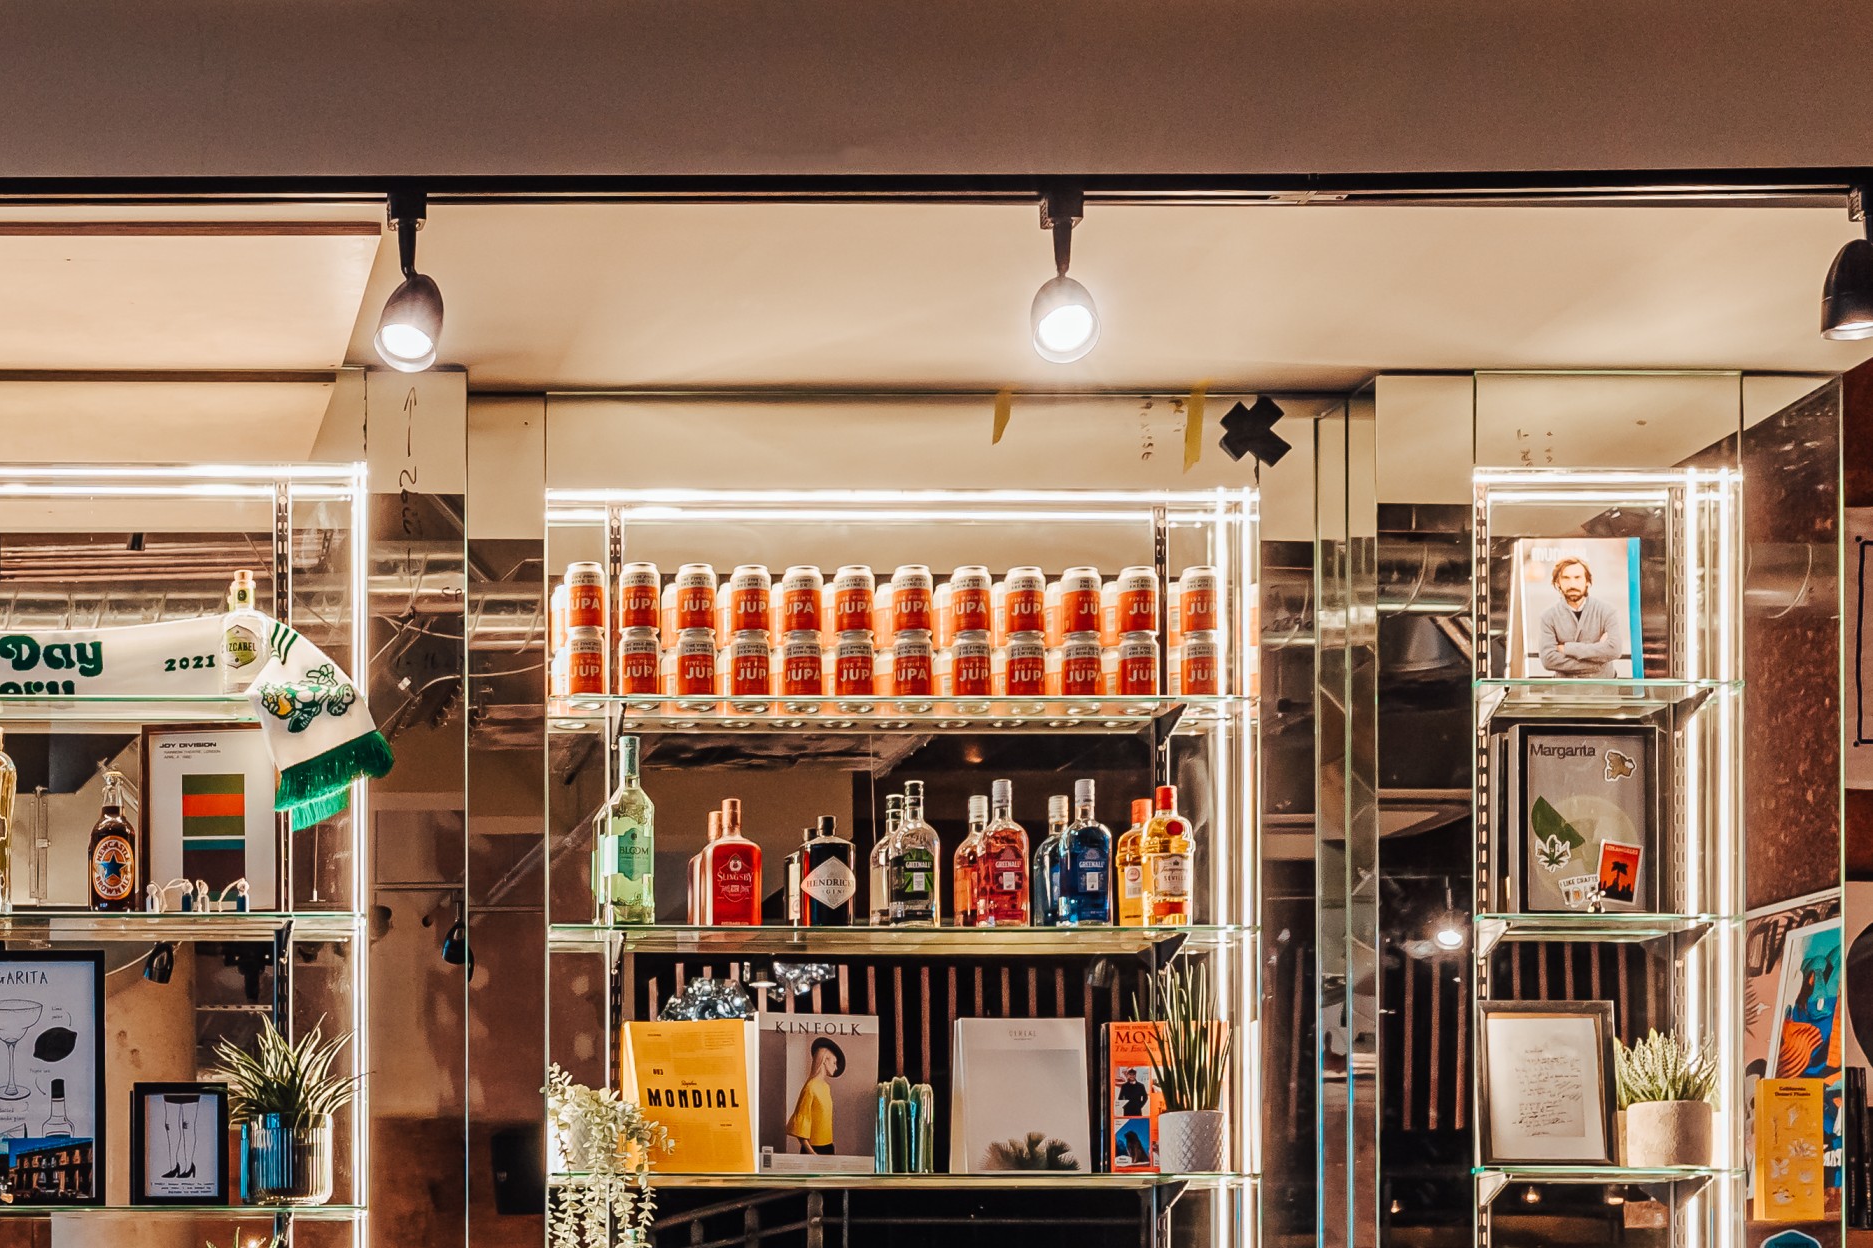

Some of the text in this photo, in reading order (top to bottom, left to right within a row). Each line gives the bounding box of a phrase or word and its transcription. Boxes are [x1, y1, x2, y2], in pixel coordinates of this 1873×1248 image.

[164, 654, 216, 672] 2021
[1530, 743, 1596, 758] Margarita
[96, 840, 130, 861] NEWCASTLE
[619, 846, 650, 855] BLOOM
[95, 875, 131, 894] BROWN ALE
[717, 871, 754, 883] SLINGSBY
[775, 1021, 862, 1036] KINFOLK
[647, 1087, 739, 1108] MONDIAL
